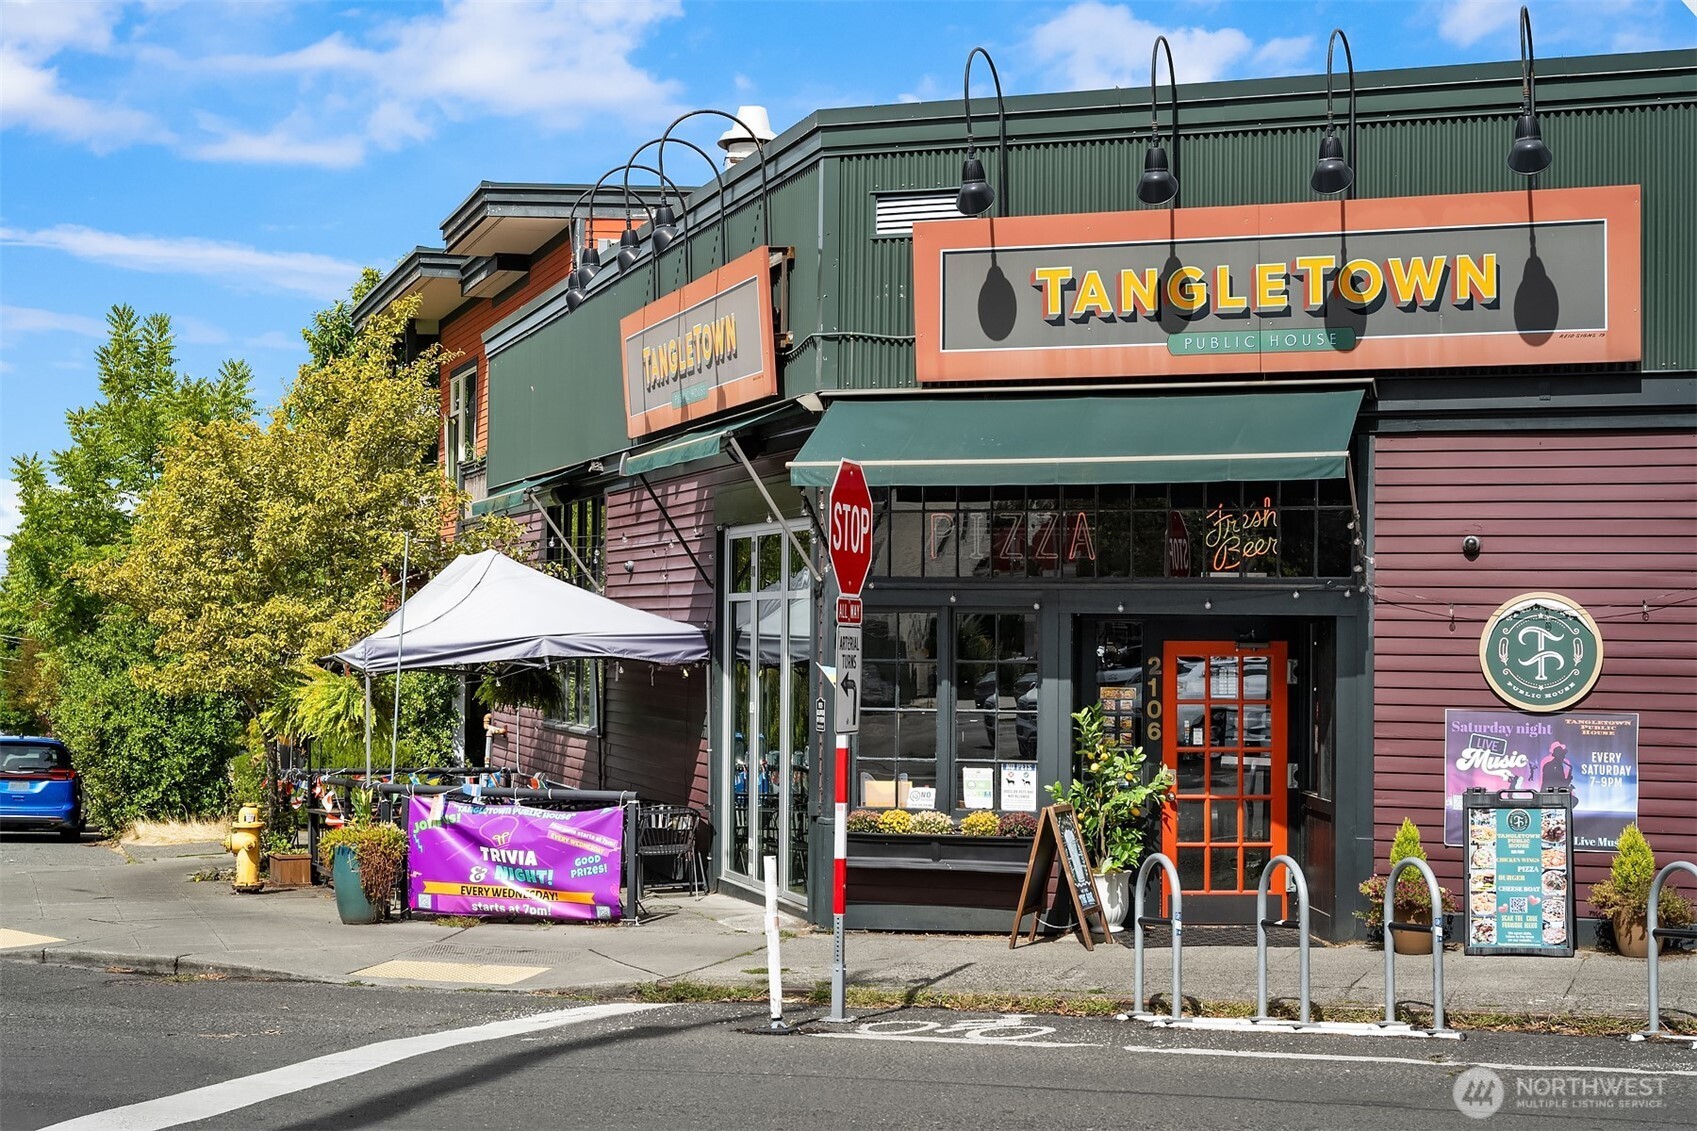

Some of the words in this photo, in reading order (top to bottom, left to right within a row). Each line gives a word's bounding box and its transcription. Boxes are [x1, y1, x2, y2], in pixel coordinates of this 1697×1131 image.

[1031, 254, 1500, 326] TANGLETOWN
[1184, 335, 1255, 350] PUBLIC
[1270, 332, 1337, 347] HOUSE
[642, 313, 737, 393] TANGLETOWN
[833, 501, 870, 553] STOP
[931, 512, 1096, 560] PIZZA
[1213, 536, 1278, 571] Beer
[839, 604, 848, 619] ALL
[850, 604, 861, 619] WAY
[839, 636, 860, 651] ARTERIAL
[842, 654, 857, 669] TURNS
[1506, 681, 1541, 699] PUBLIC
[1544, 681, 1577, 698] HOUSE
[1147, 657, 1162, 741] 2106
[1451, 720, 1514, 737] Saturday
[1516, 723, 1553, 738] night
[1564, 718, 1633, 726] TANGLETOWN
[1476, 737, 1500, 752] LIVE
[1456, 748, 1528, 775] Music
[1591, 751, 1622, 764] EVERY
[1581, 763, 1632, 777] SATURDAY
[1590, 776, 1623, 788] 7-9PM
[1573, 836, 1597, 847] Live
[1597, 837, 1619, 847] Mus
[480, 846, 538, 866] TRIVIA
[574, 855, 601, 867] GOOD
[469, 865, 488, 883] &
[495, 865, 554, 886] NIGHT!
[1517, 865, 1540, 873] PIZZA
[460, 885, 490, 897] EVERY
[471, 902, 506, 912] starts
[508, 904, 520, 913] at
[522, 904, 553, 916] 7pm!
